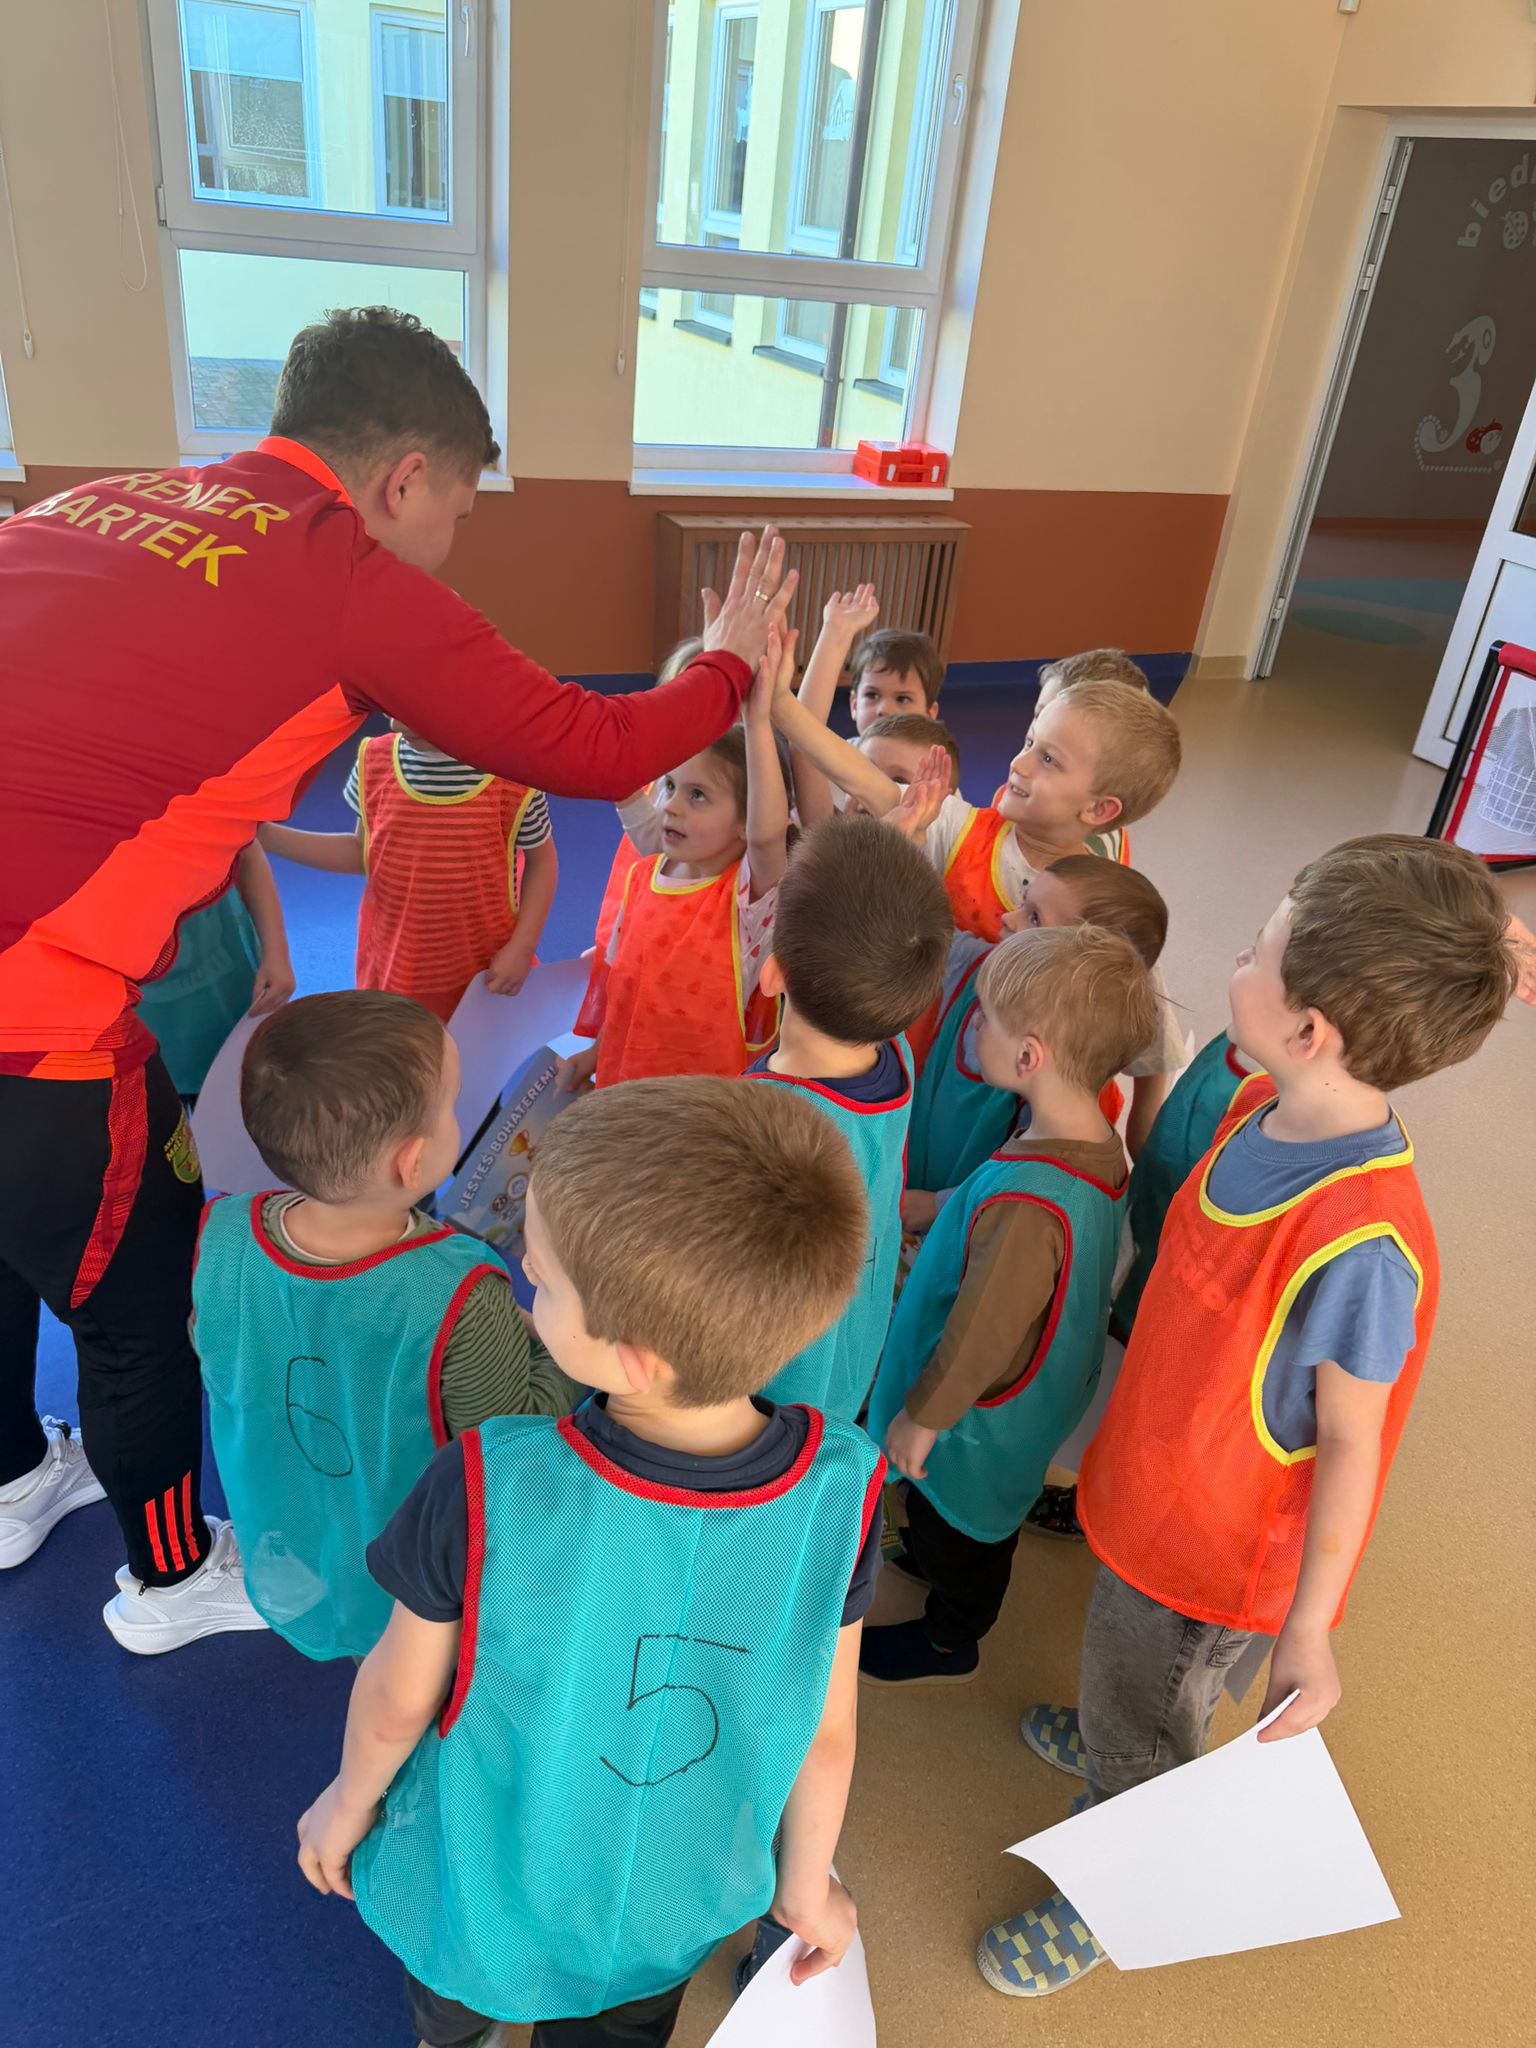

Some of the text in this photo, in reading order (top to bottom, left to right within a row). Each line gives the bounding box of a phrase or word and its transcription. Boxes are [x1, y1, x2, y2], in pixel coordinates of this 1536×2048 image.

[23, 491, 248, 587] BARTEK
[105, 473, 290, 536] RENER
[459, 1065, 557, 1209] JESTEŚ BOHATEREM!
[599, 1634, 752, 1788] 5
